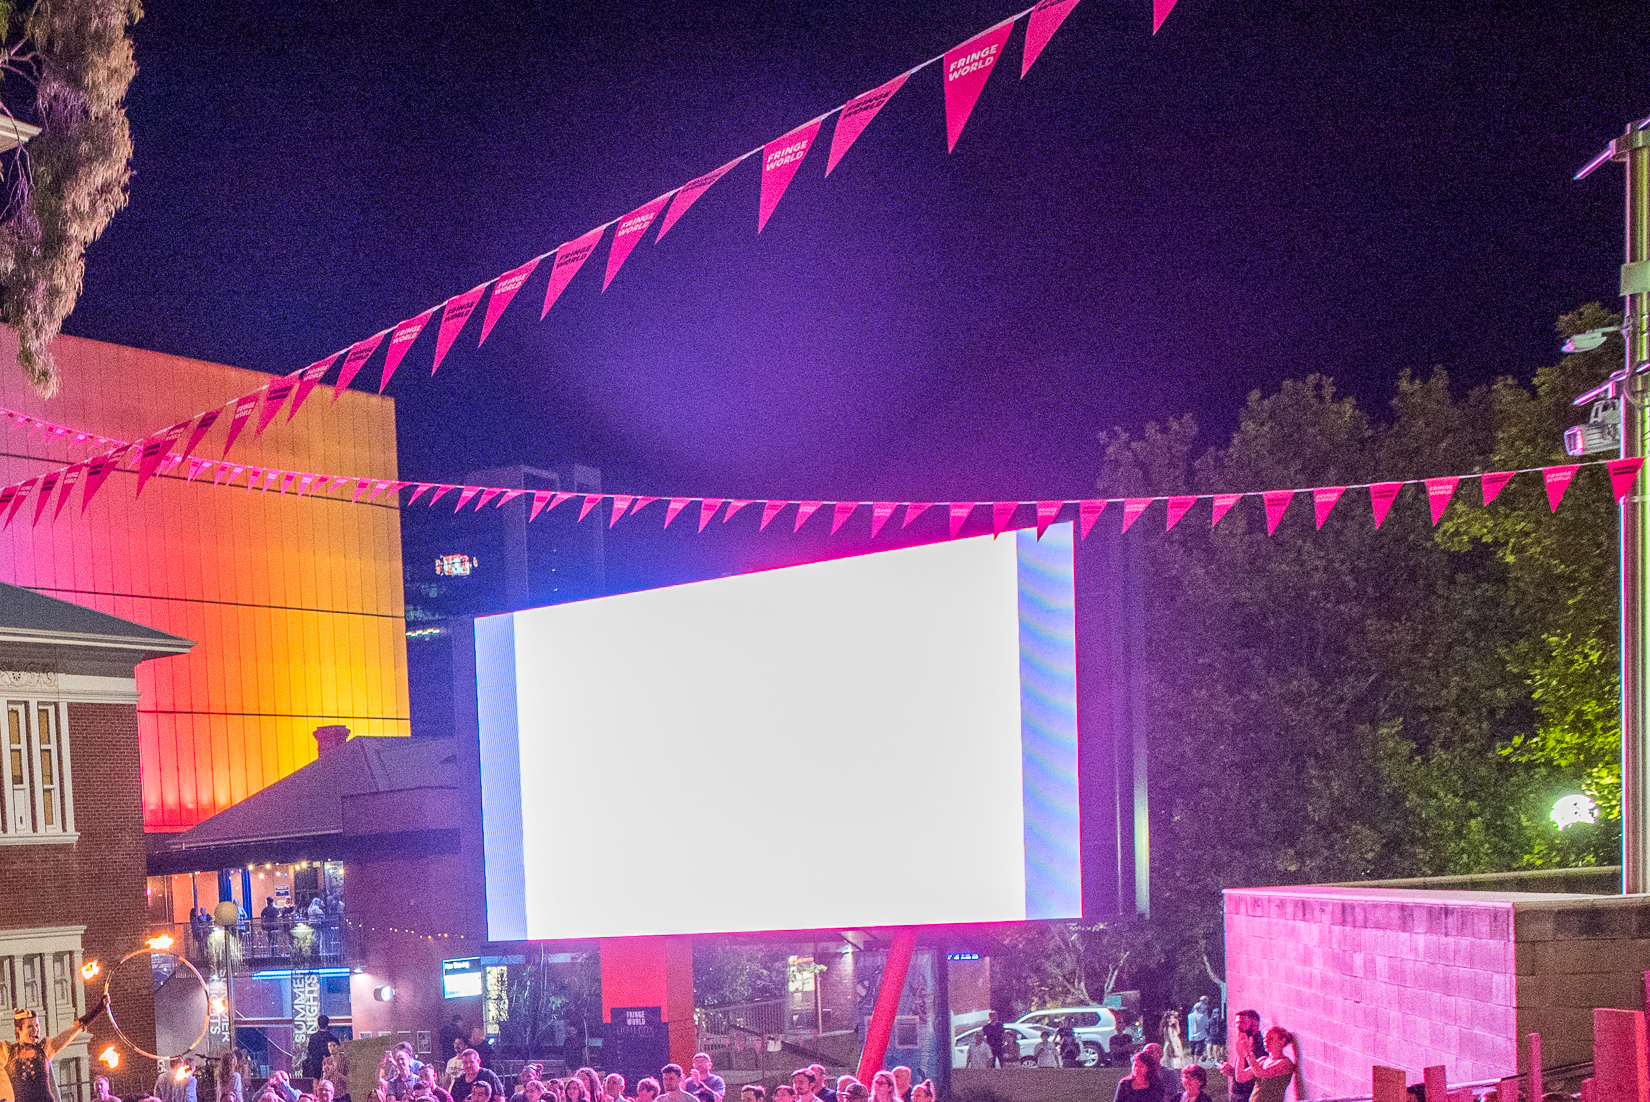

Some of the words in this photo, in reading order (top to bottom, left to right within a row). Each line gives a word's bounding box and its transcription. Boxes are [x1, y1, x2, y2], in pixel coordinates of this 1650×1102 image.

[949, 44, 998, 72] FRINGE
[948, 57, 994, 81] WORLD
[843, 100, 886, 120] WORLD
[847, 91, 892, 112] FRINGE
[765, 151, 804, 172] WORLD
[766, 140, 808, 163] FRINGE
[617, 221, 650, 237] WORLD
[620, 212, 656, 229] FRINGE
[494, 281, 522, 295] WORLD
[305, 974, 319, 1035] NIGHTS
